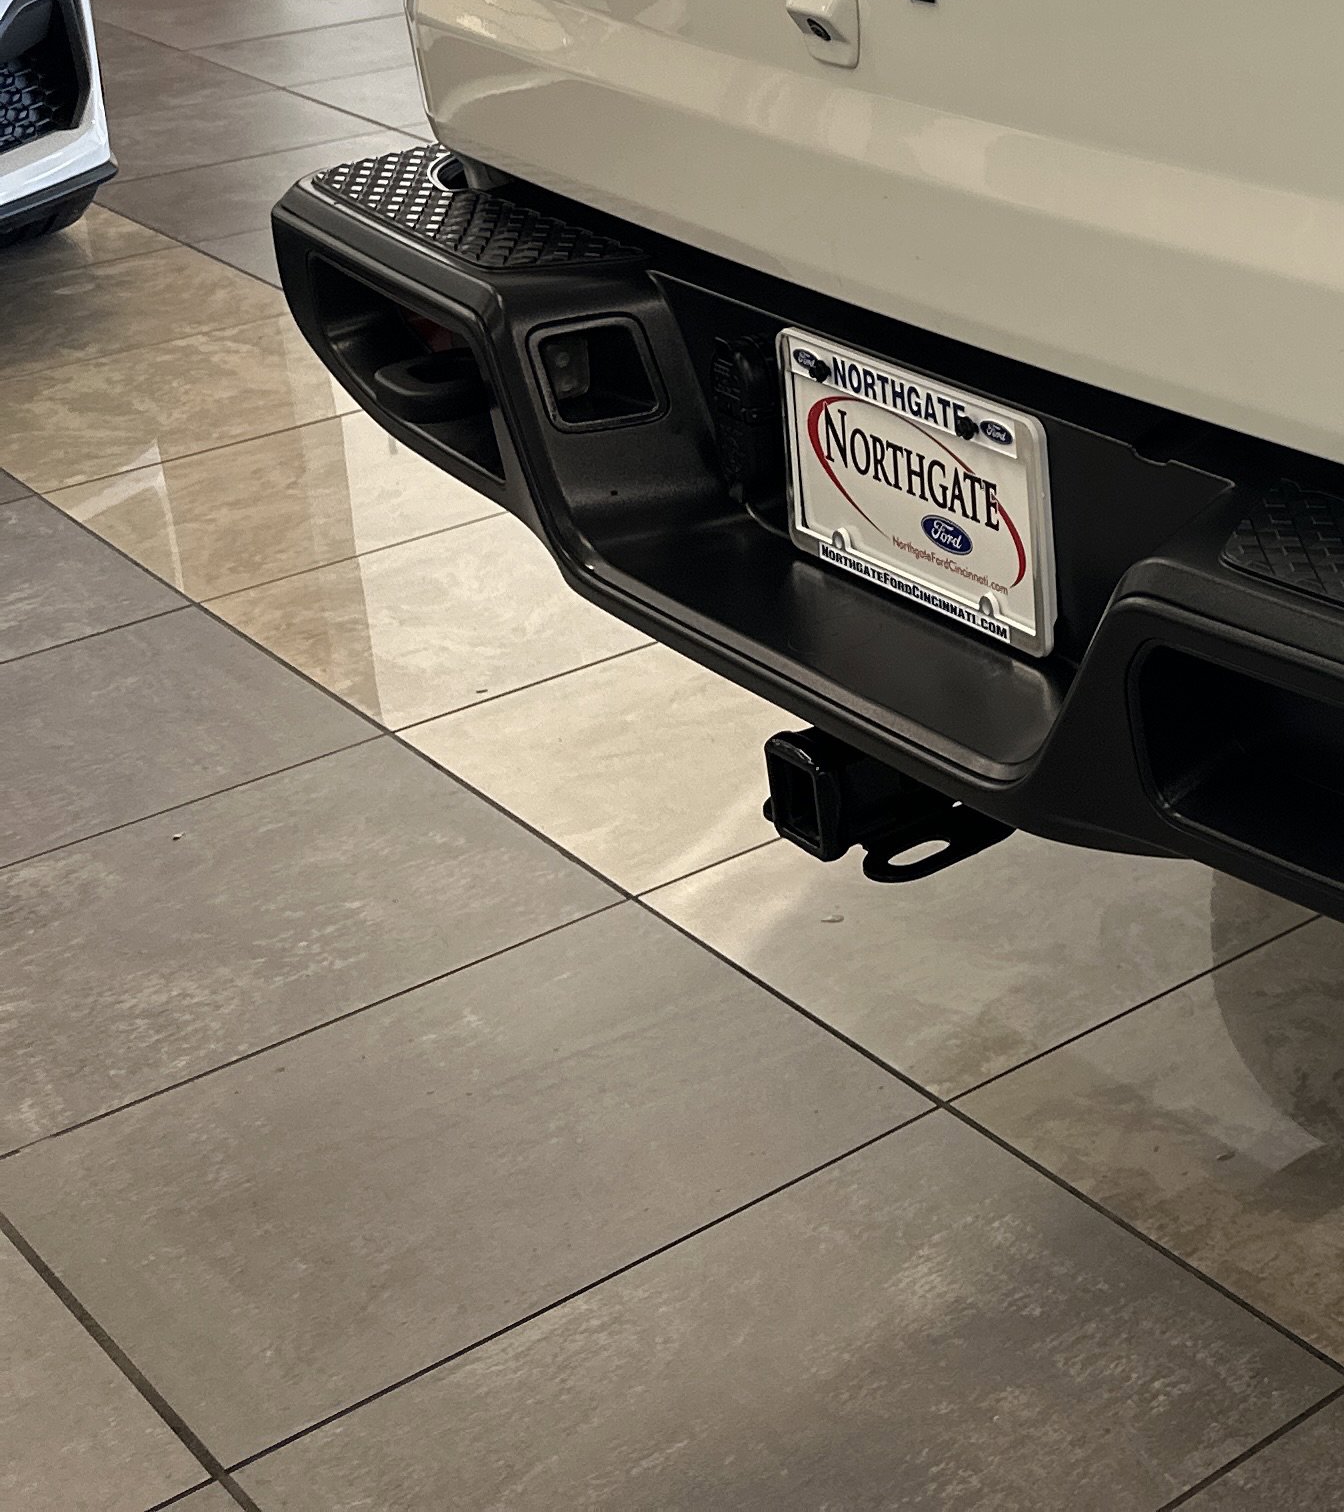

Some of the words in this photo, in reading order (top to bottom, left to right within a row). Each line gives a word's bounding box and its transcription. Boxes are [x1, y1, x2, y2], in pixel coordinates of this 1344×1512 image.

[832, 356, 967, 430] NORTHGATE
[986, 423, 1007, 442] Ford
[823, 401, 1000, 531] NORTHGATE
[931, 519, 963, 550] Ford
[892, 536, 1009, 596] NorthgateFordCincinnati.com
